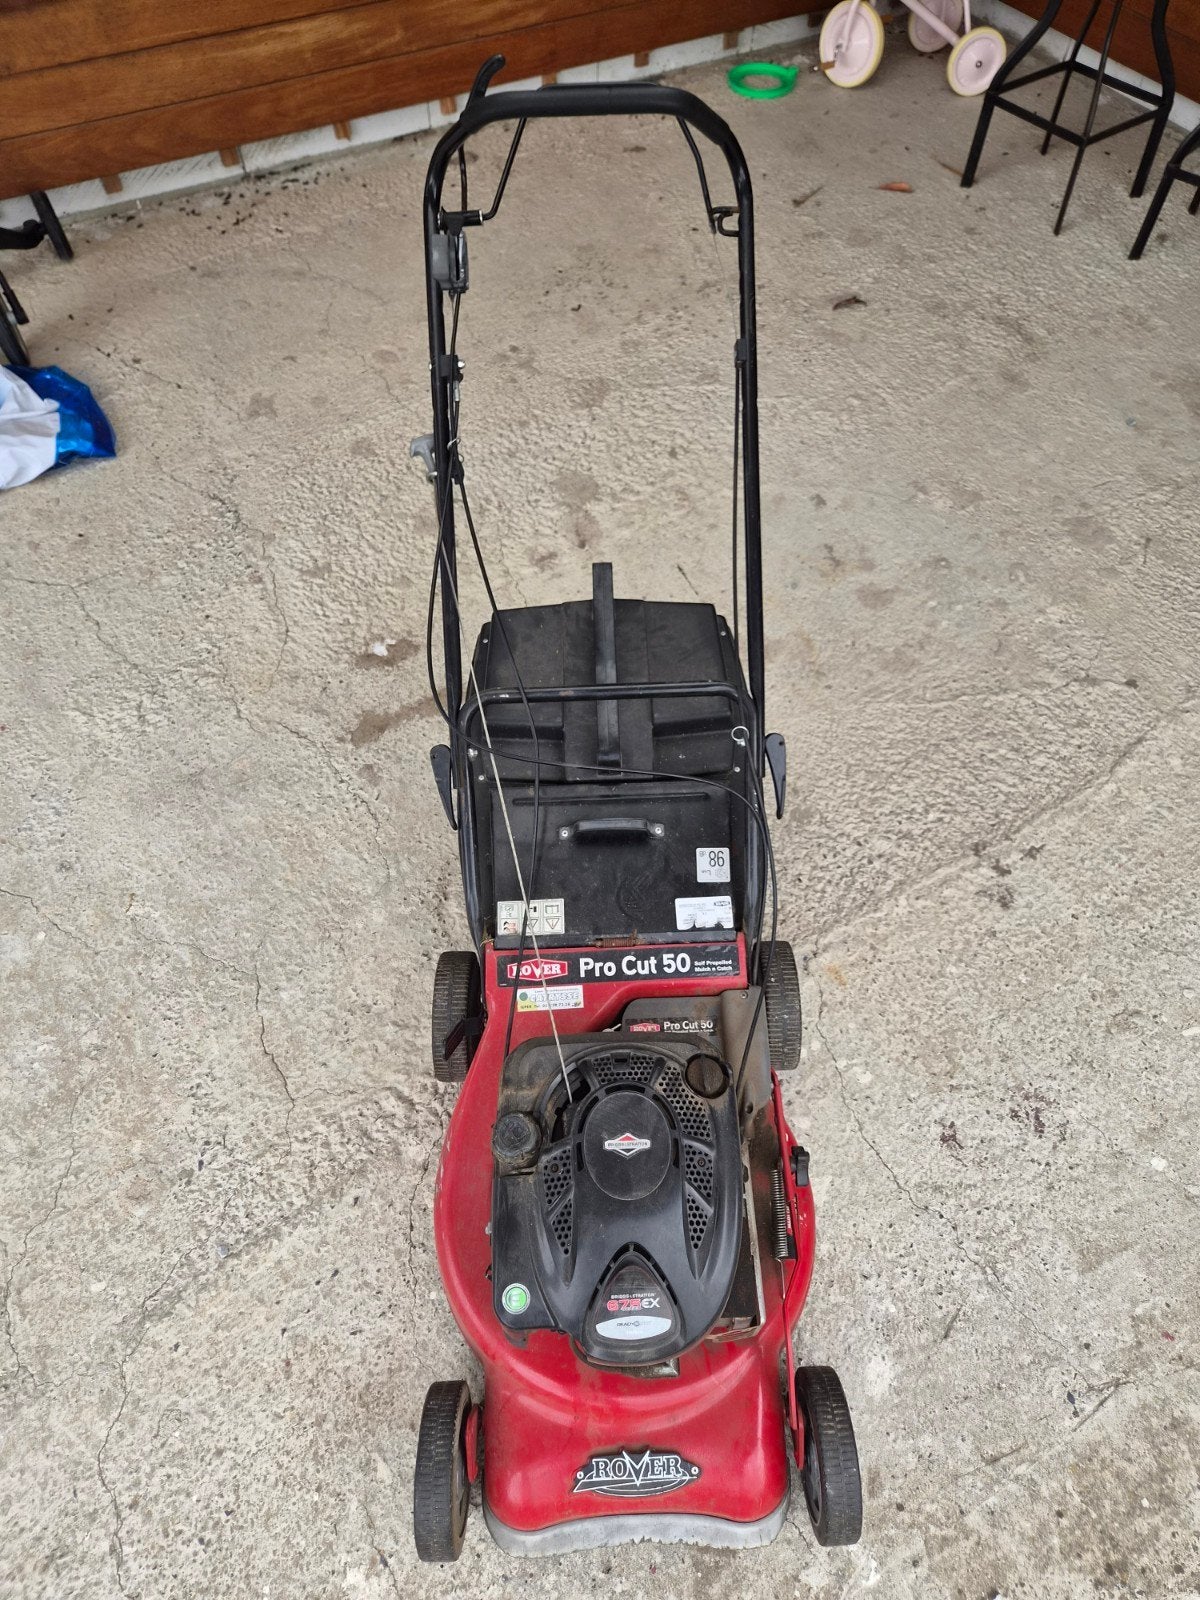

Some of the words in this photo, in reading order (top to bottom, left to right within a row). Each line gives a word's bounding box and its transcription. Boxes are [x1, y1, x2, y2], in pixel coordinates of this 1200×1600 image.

[580, 957, 613, 978] Pro
[622, 955, 657, 976] Cut
[663, 953, 691, 974] 50
[663, 1021, 681, 1030] Pro
[682, 1021, 699, 1030] Cut
[700, 1020, 714, 1029] 50
[592, 1450, 682, 1487] ROVER
